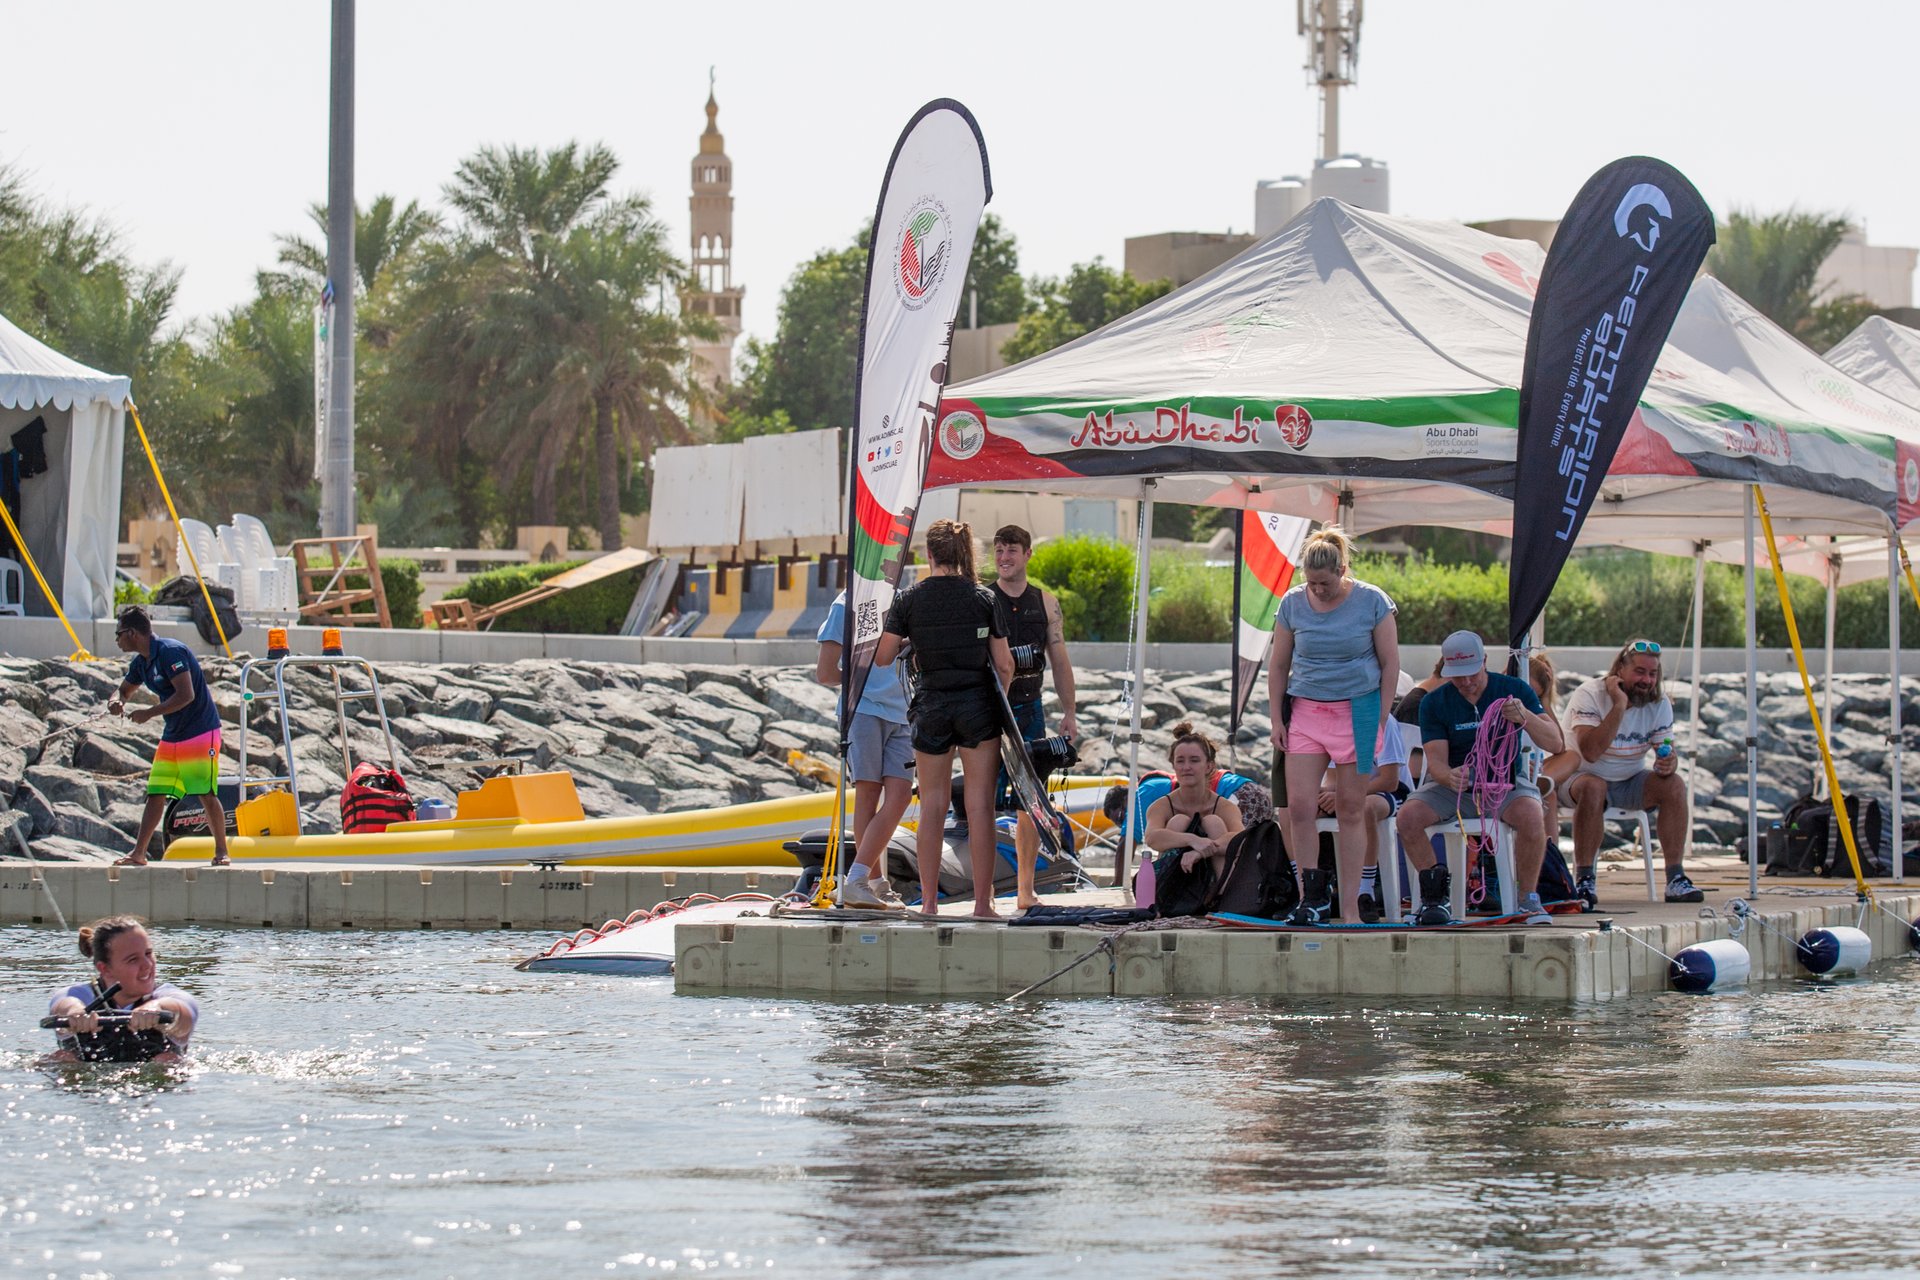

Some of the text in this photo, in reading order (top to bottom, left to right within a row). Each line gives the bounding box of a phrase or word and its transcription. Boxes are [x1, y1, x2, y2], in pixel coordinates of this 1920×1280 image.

[1425, 437, 1479, 447] Sports Council
[1426, 426, 1479, 437] Abu Dhabi
[1550, 328, 1592, 448] Perfect ride. Every time.
[1555, 265, 1649, 541] CENTURION
[1558, 312, 1614, 477] BOATS
